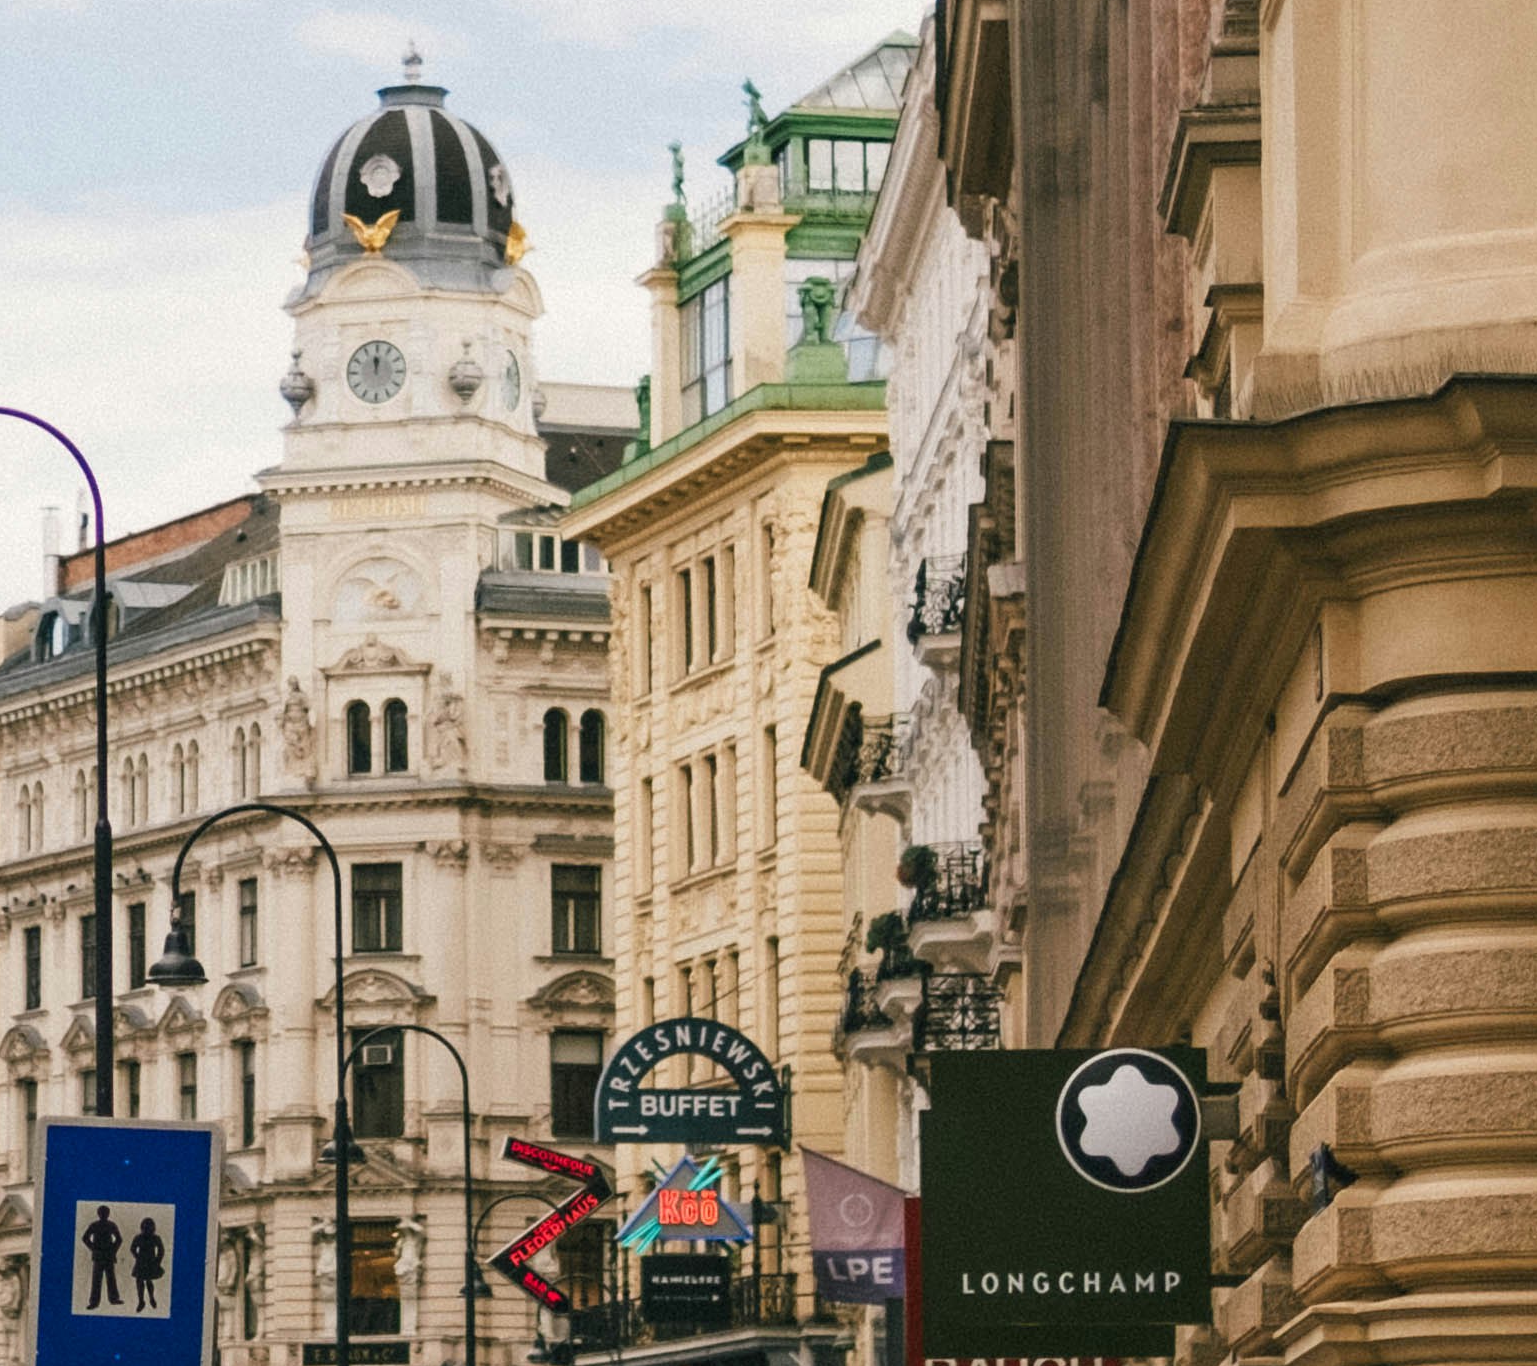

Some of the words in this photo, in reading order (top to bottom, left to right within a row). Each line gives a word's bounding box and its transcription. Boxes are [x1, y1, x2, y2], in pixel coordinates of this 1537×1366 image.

[608, 1025, 775, 1110] TRZESNIEWSKI
[640, 1095, 741, 1117] BUFFET
[511, 1141, 595, 1176] DISCOTHEQUE
[659, 1190, 719, 1226] Köö
[962, 1271, 1181, 1295] LONGCHAMP
